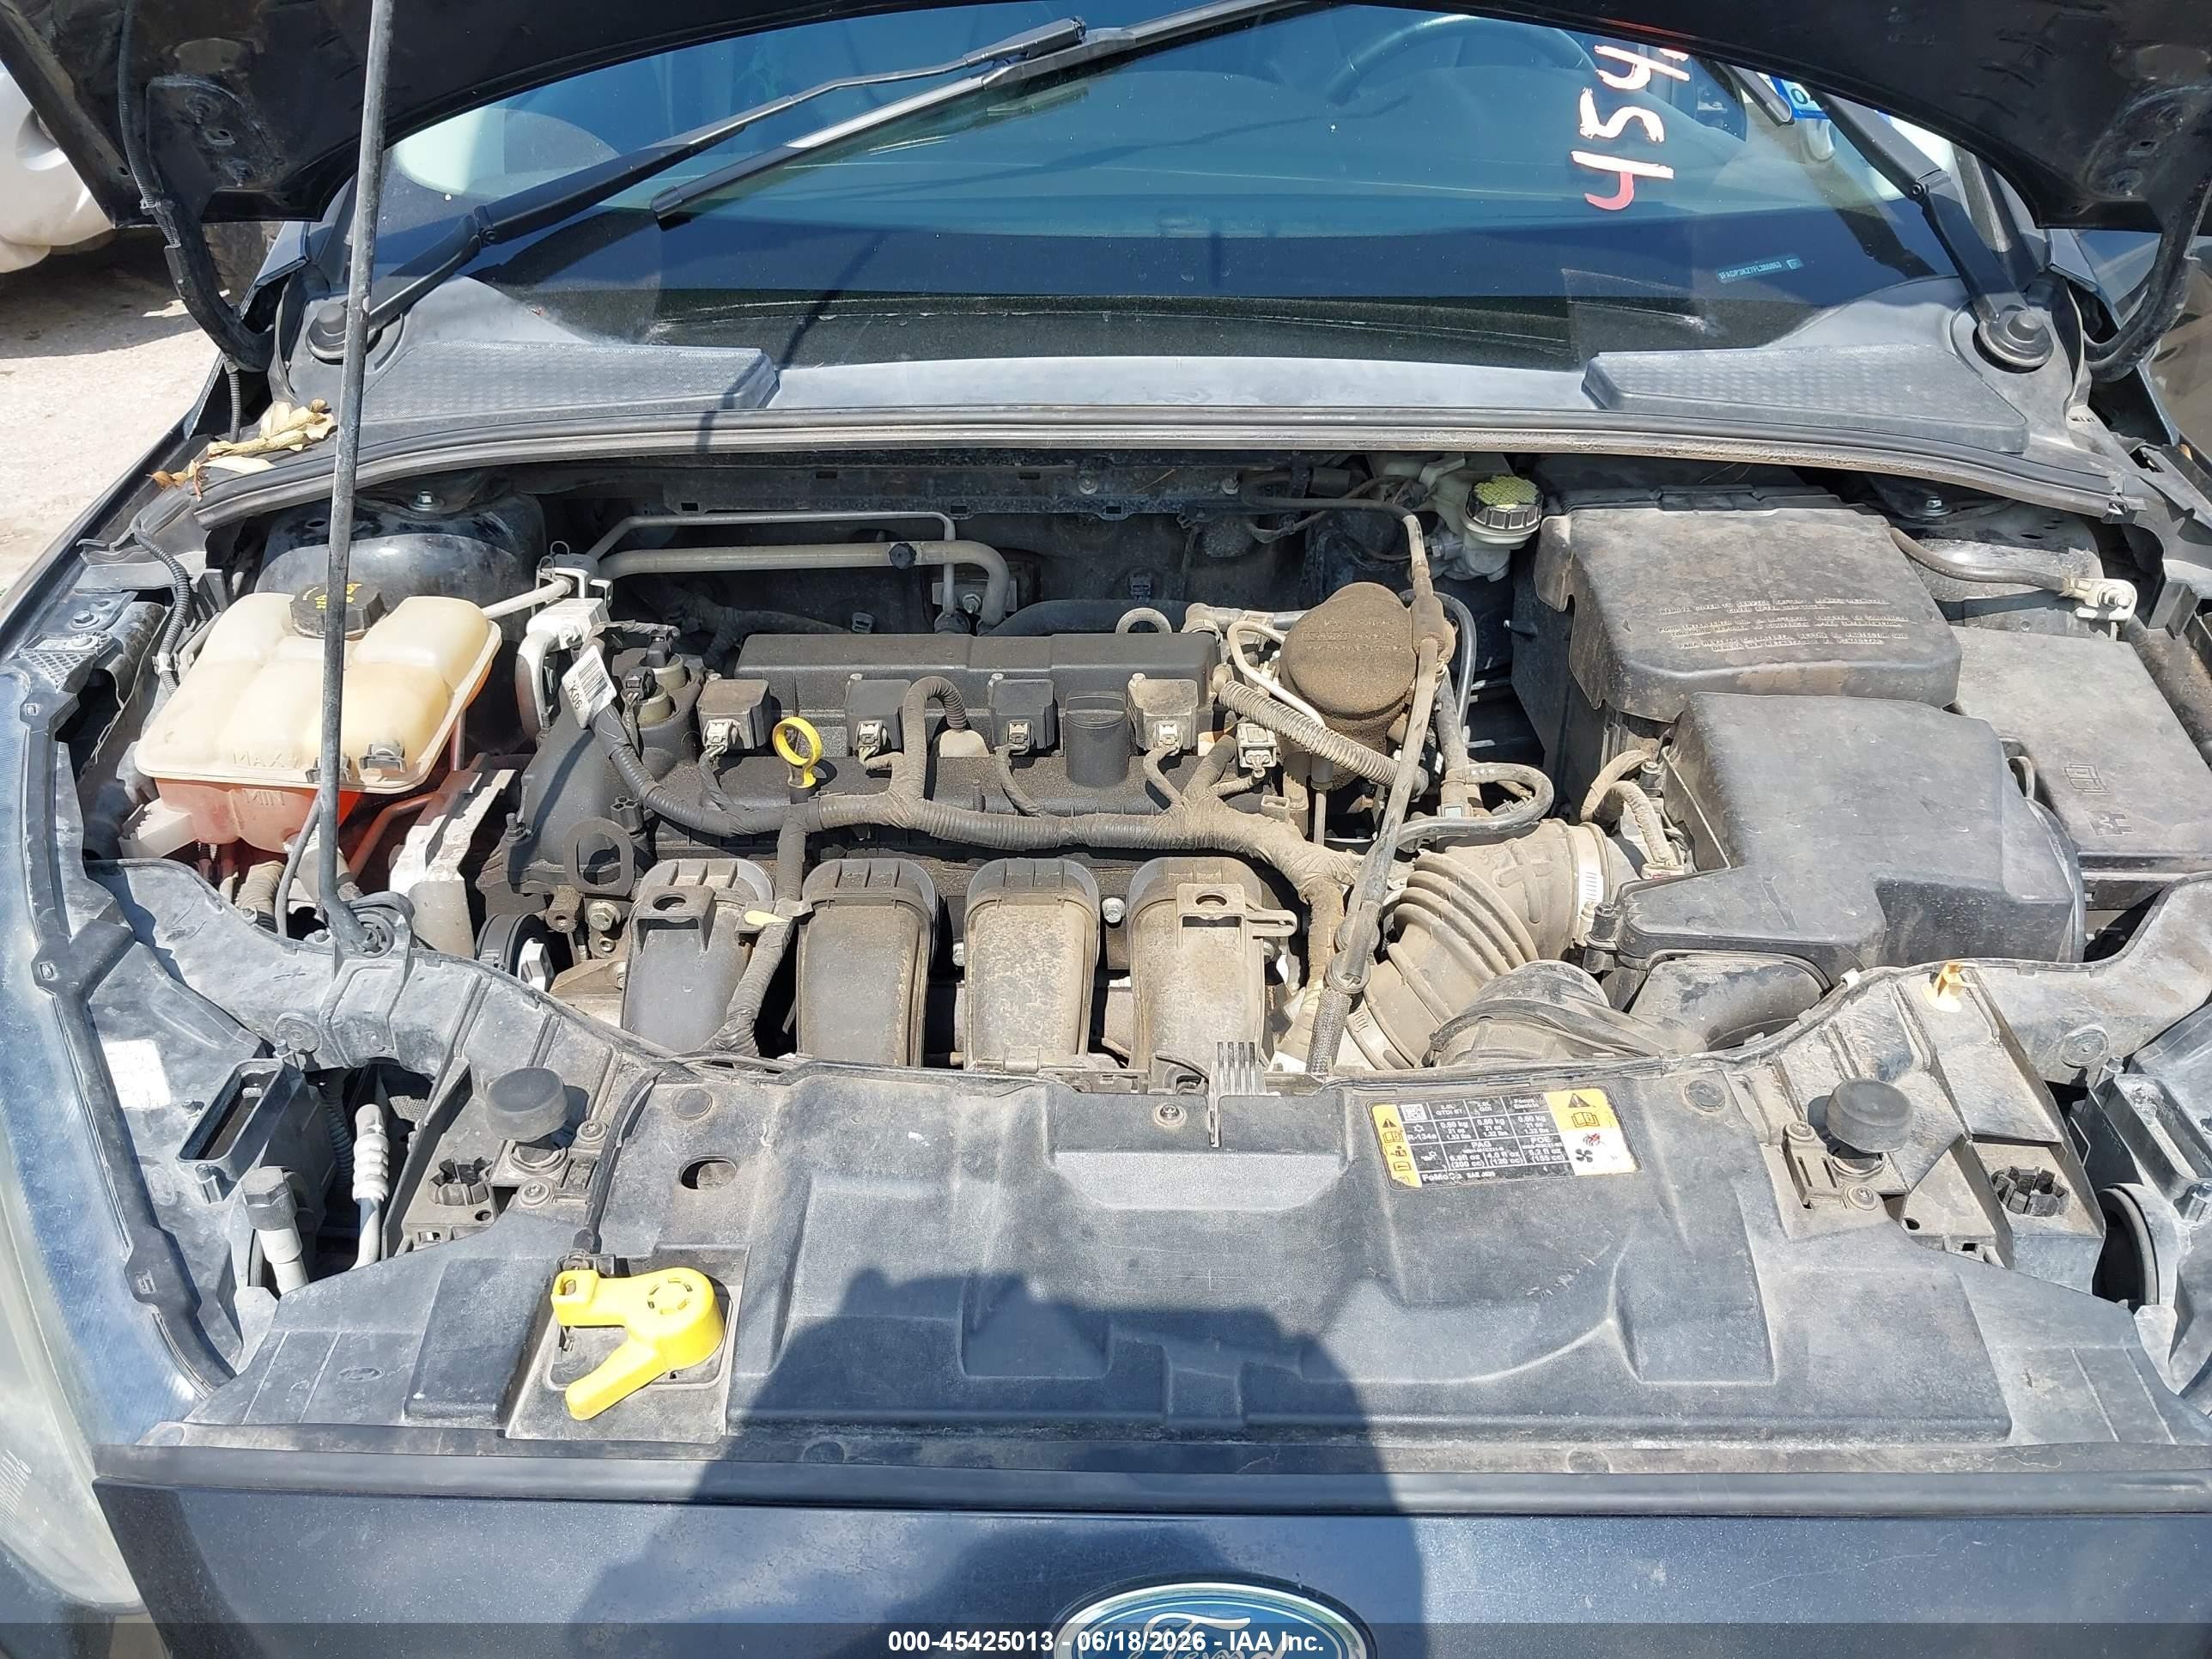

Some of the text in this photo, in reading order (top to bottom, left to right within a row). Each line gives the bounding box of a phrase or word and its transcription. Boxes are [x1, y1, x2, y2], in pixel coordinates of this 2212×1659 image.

[1571, 45, 1690, 211] 454
[568, 685, 583, 709] K06
[241, 788, 286, 805] MIN
[1457, 1121, 1469, 1129] kg
[1494, 1117, 1505, 1126] kg
[1407, 1133, 1437, 1141] R-134a
